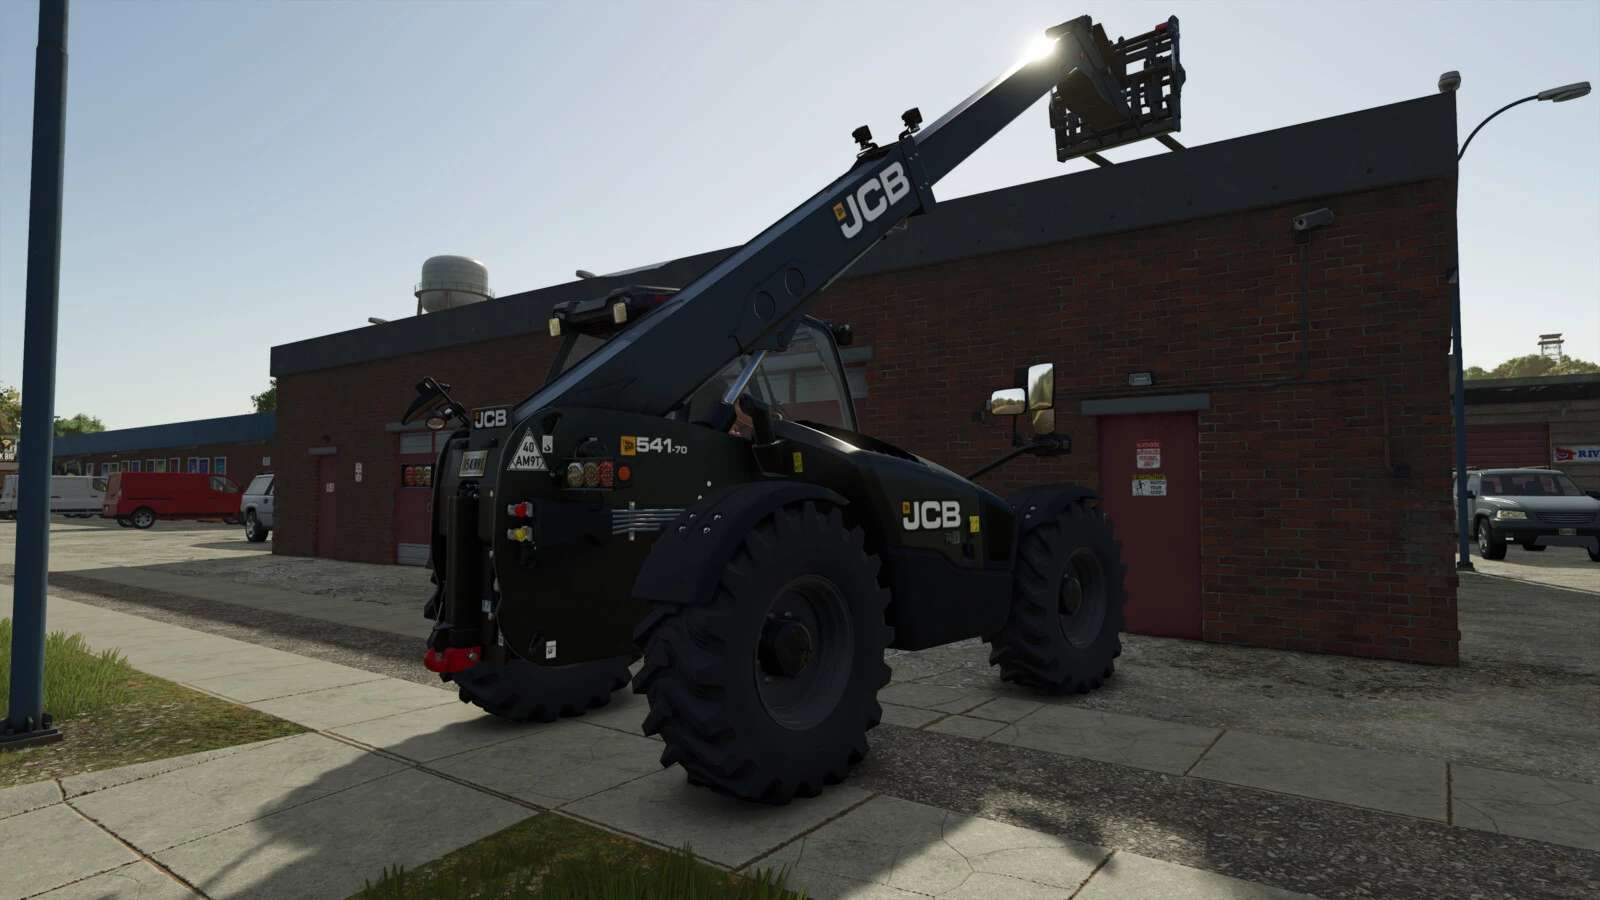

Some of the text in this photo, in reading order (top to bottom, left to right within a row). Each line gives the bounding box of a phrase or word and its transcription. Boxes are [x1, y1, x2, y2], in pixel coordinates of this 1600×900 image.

[840, 161, 910, 238] JCB
[474, 408, 507, 428] JCB
[522, 442, 535, 453] 40
[516, 455, 542, 467] AM9T
[902, 500, 961, 530] JCB
